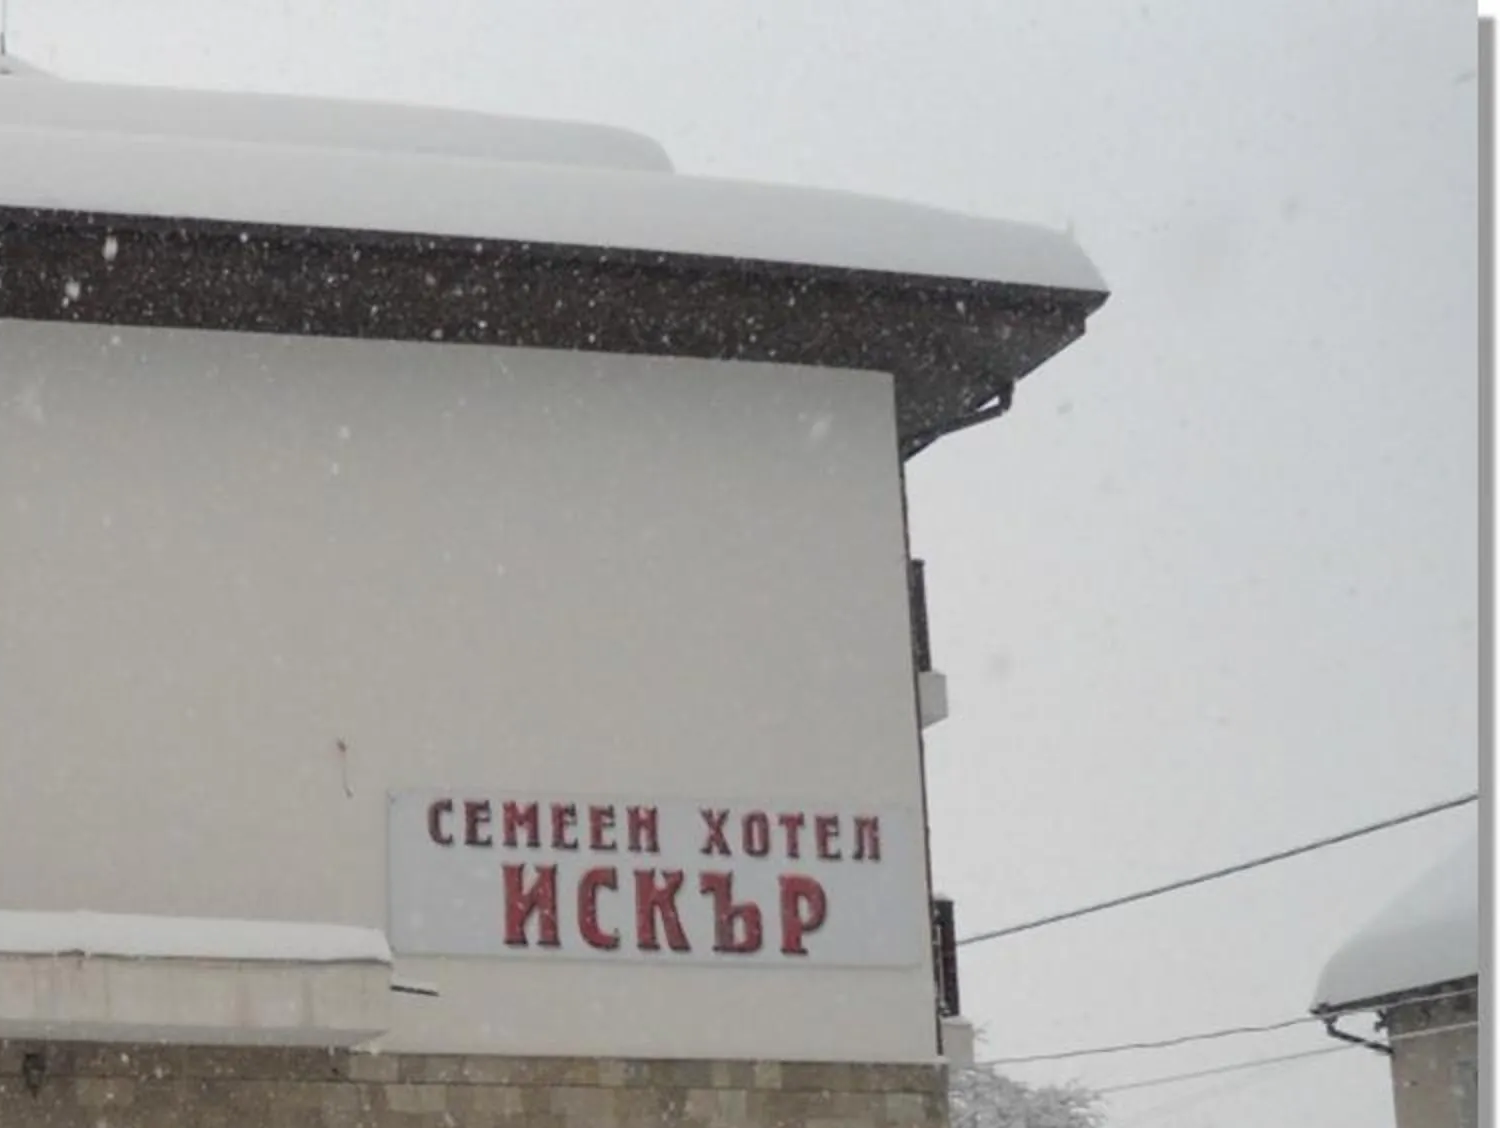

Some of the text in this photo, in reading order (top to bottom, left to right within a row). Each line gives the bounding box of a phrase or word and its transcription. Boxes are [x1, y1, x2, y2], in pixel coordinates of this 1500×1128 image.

[427, 799, 883, 862] СЕМЕЕН ХОТЕЛ
[501, 862, 828, 956] ИСКЪР
